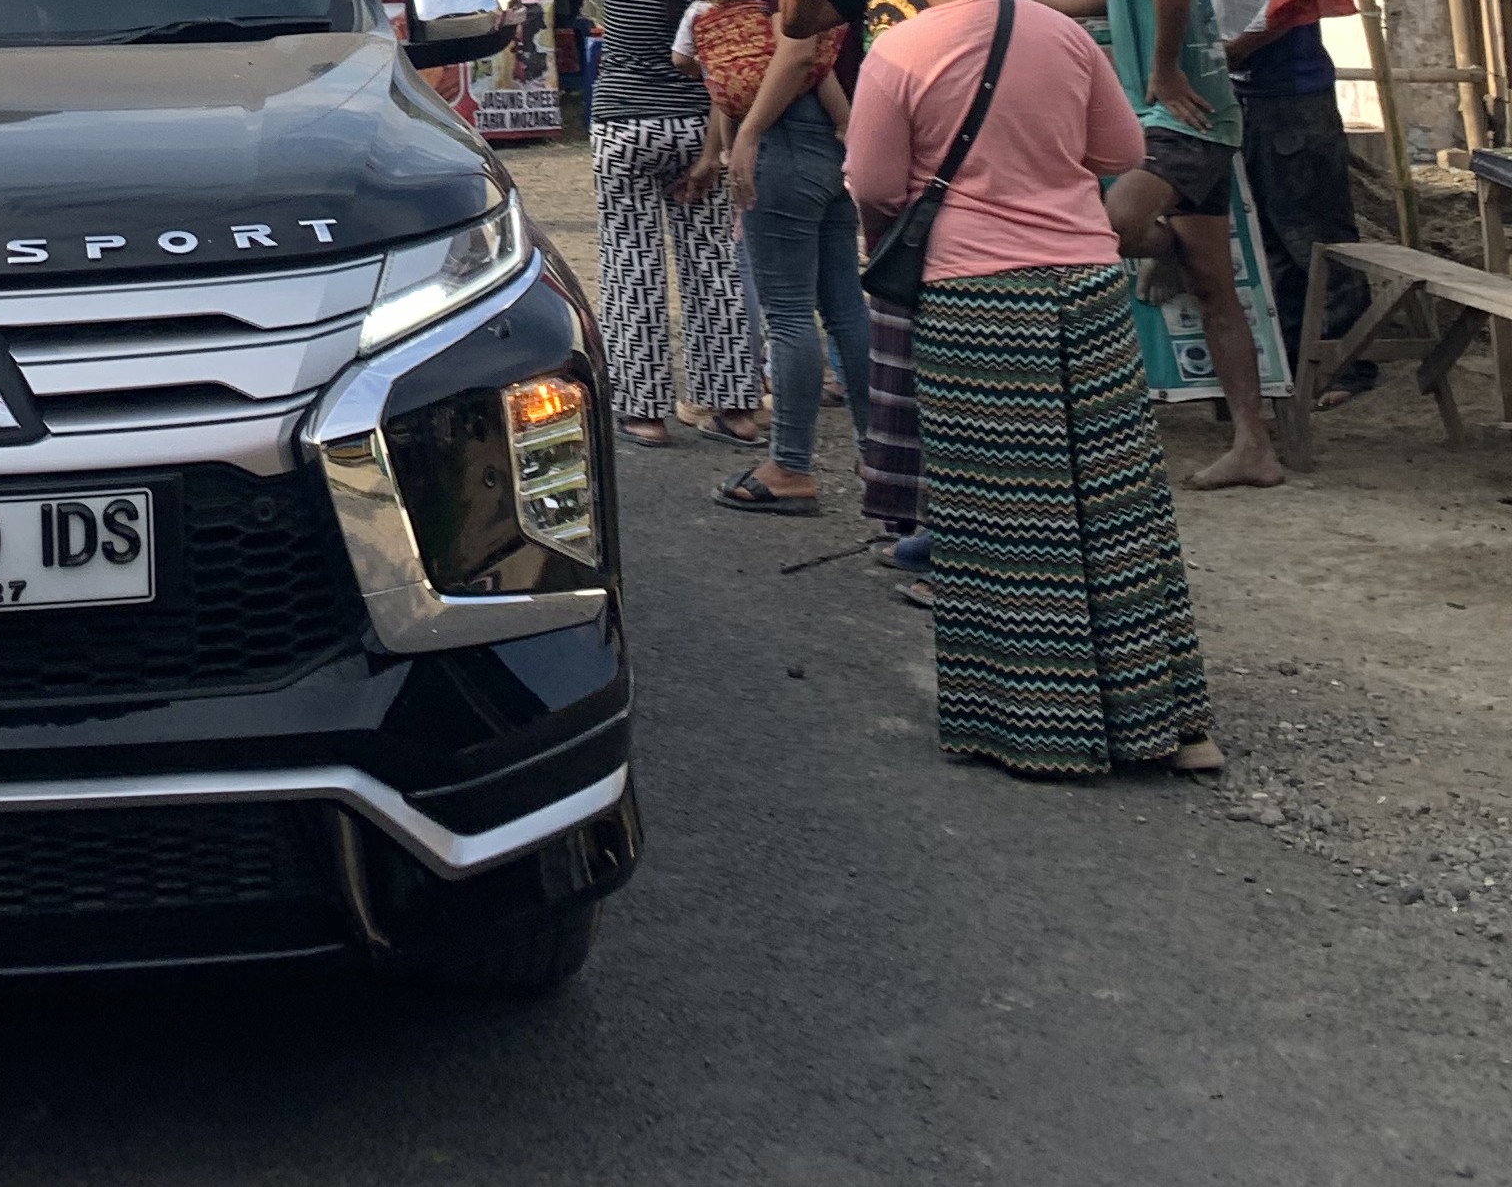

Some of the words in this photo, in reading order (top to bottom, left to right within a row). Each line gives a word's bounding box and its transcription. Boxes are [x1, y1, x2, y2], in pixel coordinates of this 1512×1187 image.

[481, 91, 523, 109] JAGUNG
[476, 112, 506, 129] TARIK
[5, 218, 338, 265] SPORT
[40, 498, 142, 568] IDS
